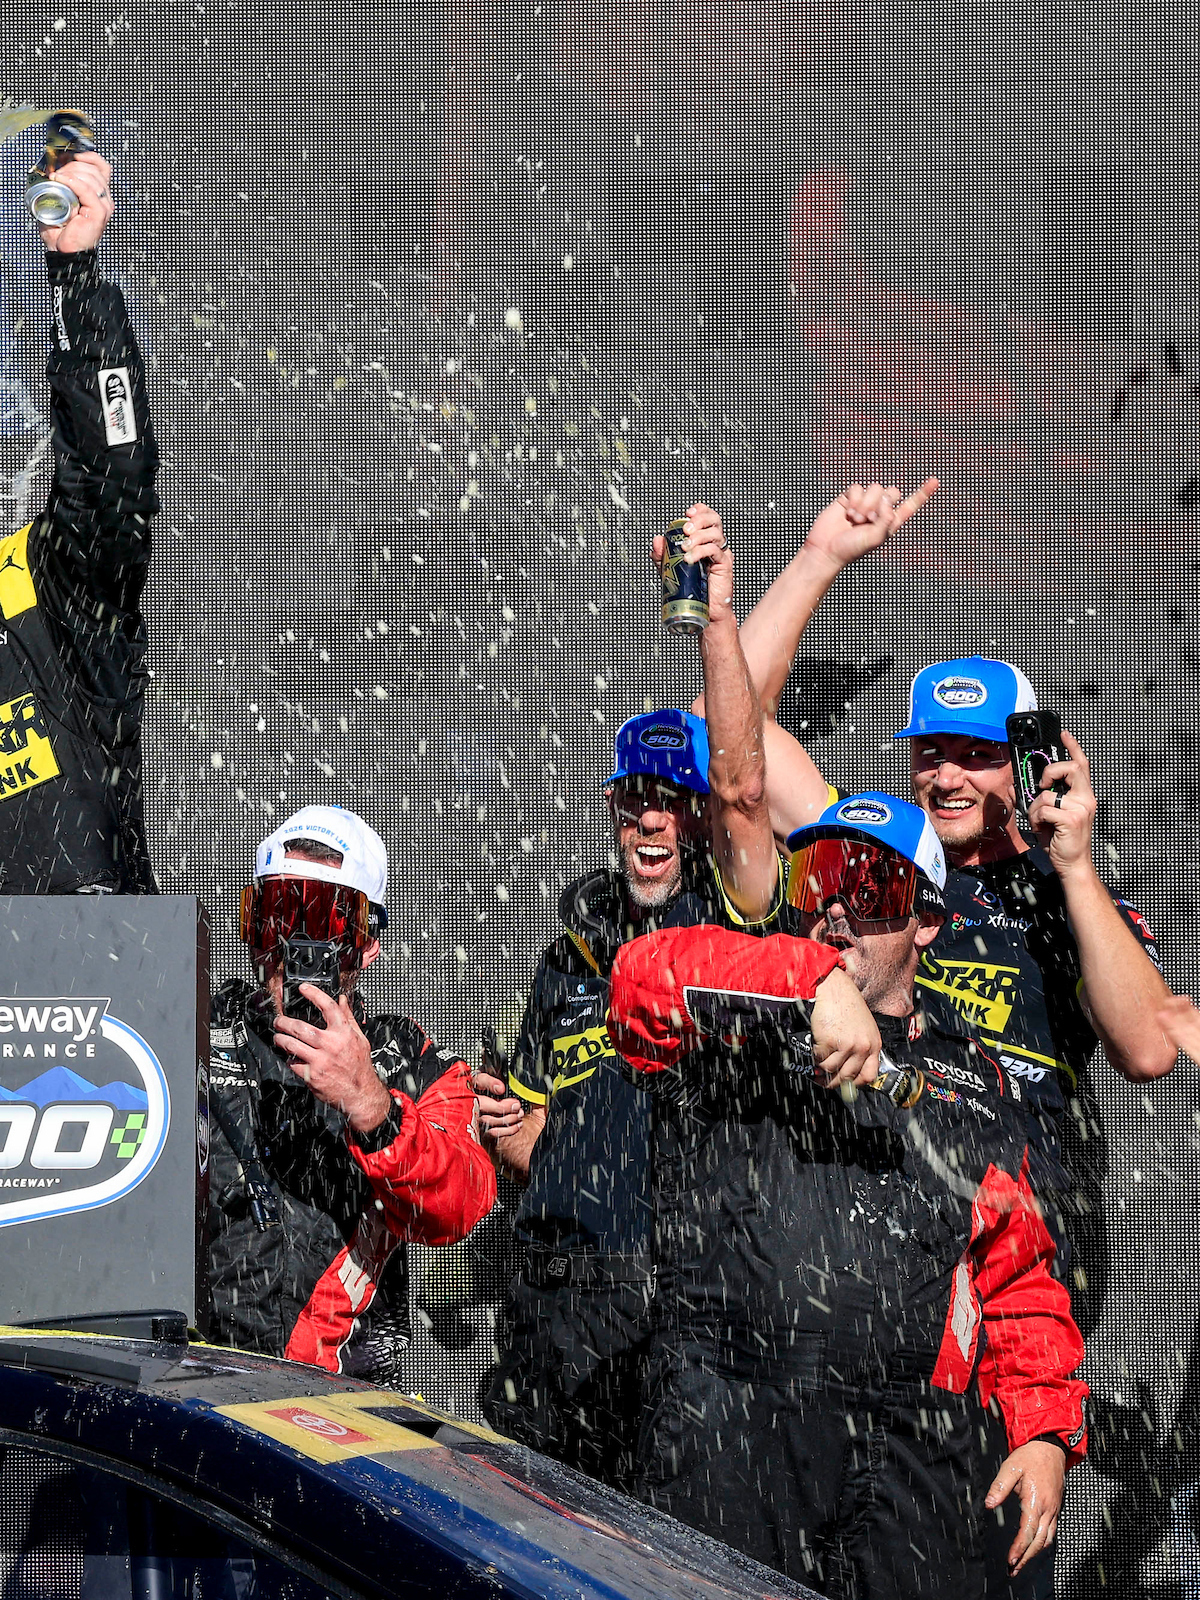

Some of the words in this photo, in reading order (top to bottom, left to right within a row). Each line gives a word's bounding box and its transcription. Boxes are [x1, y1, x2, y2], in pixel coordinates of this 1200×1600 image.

[943, 690, 979, 701] 500
[647, 735, 681, 746] 500
[305, 825, 335, 838] VICTORY
[986, 912, 1033, 932] xfinity
[923, 1056, 987, 1088] TOYOTA
[926, 1082, 962, 1099] CHUMBA
[930, 1091, 962, 1106] CASINO
[966, 1097, 996, 1121] xfinity
